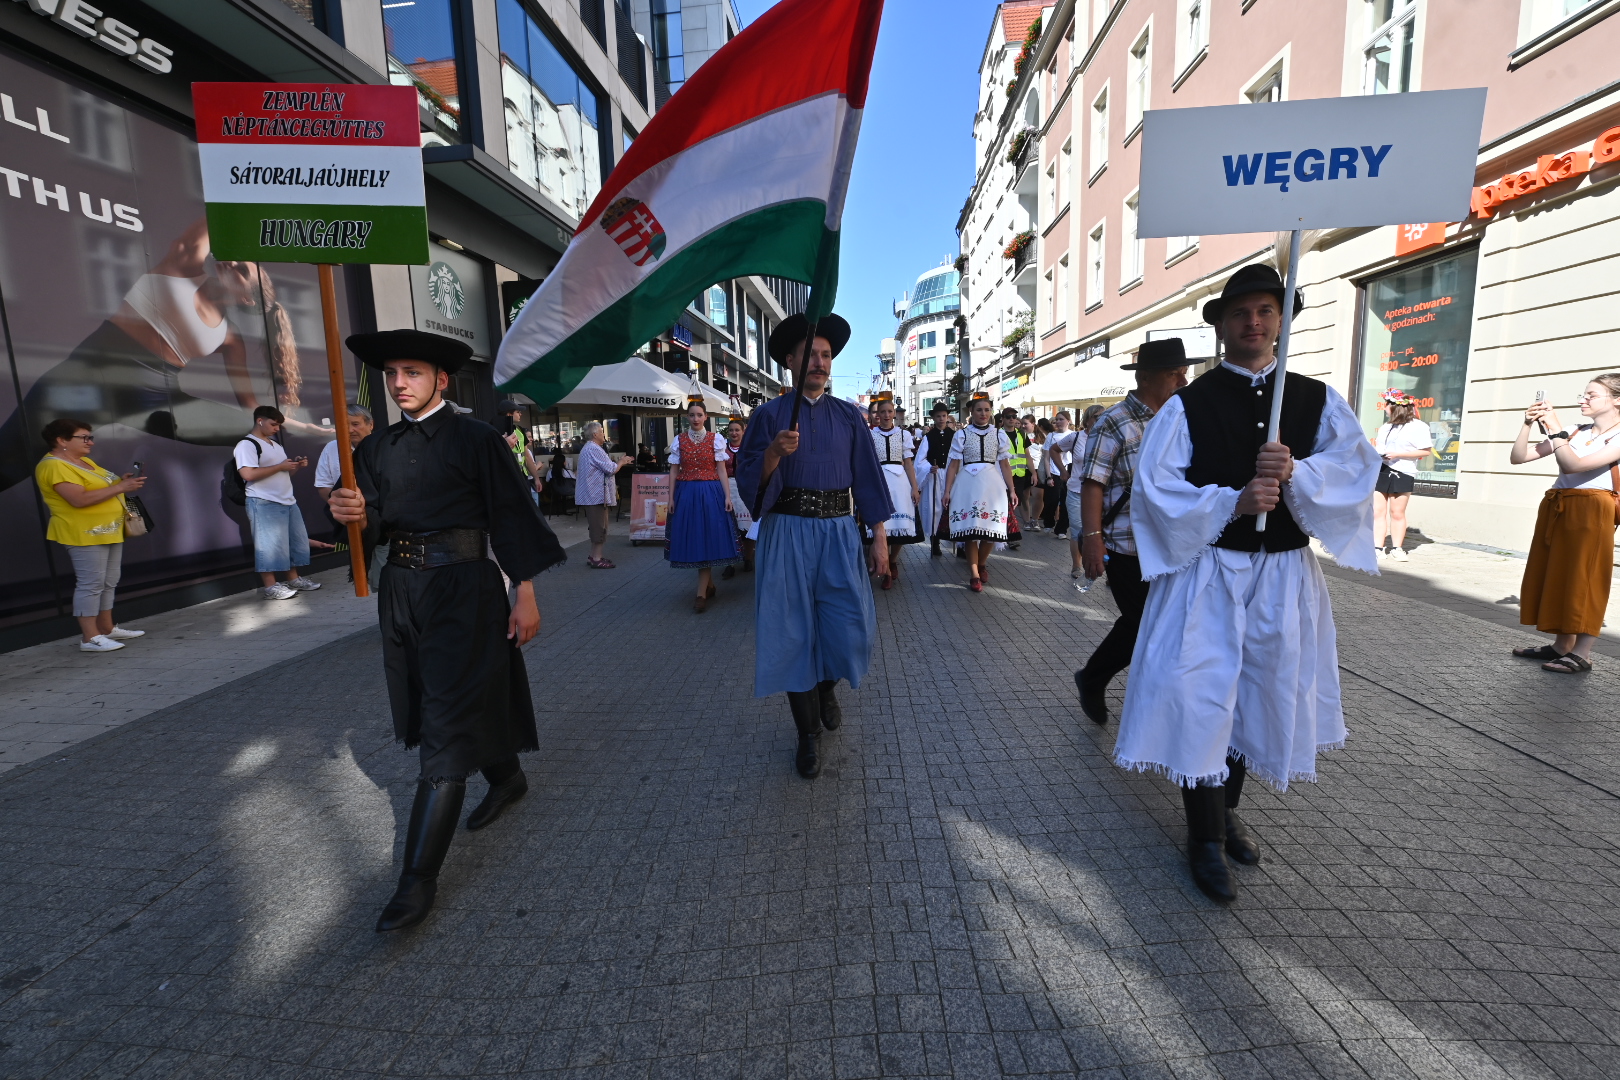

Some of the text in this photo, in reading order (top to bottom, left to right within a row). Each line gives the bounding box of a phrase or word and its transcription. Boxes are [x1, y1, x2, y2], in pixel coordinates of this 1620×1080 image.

[262, 87, 345, 112] ZEMPLÉN
[221, 112, 386, 140] NÉPTÁNCEGYÜTTES
[230, 161, 391, 188] SÁTORALJAÚJHELY
[1222, 144, 1394, 193] WĘGRY
[1470, 151, 1590, 219] pteka
[79, 191, 144, 232] US
[259, 218, 373, 249] HUNGARY
[1384, 296, 1452, 320] Apteka otwarta
[425, 318, 475, 340] STARBUCKS
[1383, 312, 1436, 332] w godzinach:
[1380, 360, 1399, 372] 8:00
[1411, 353, 1439, 368] 20:00
[1405, 346, 1416, 357] pt.
[621, 395, 676, 406] STARBUCKS
